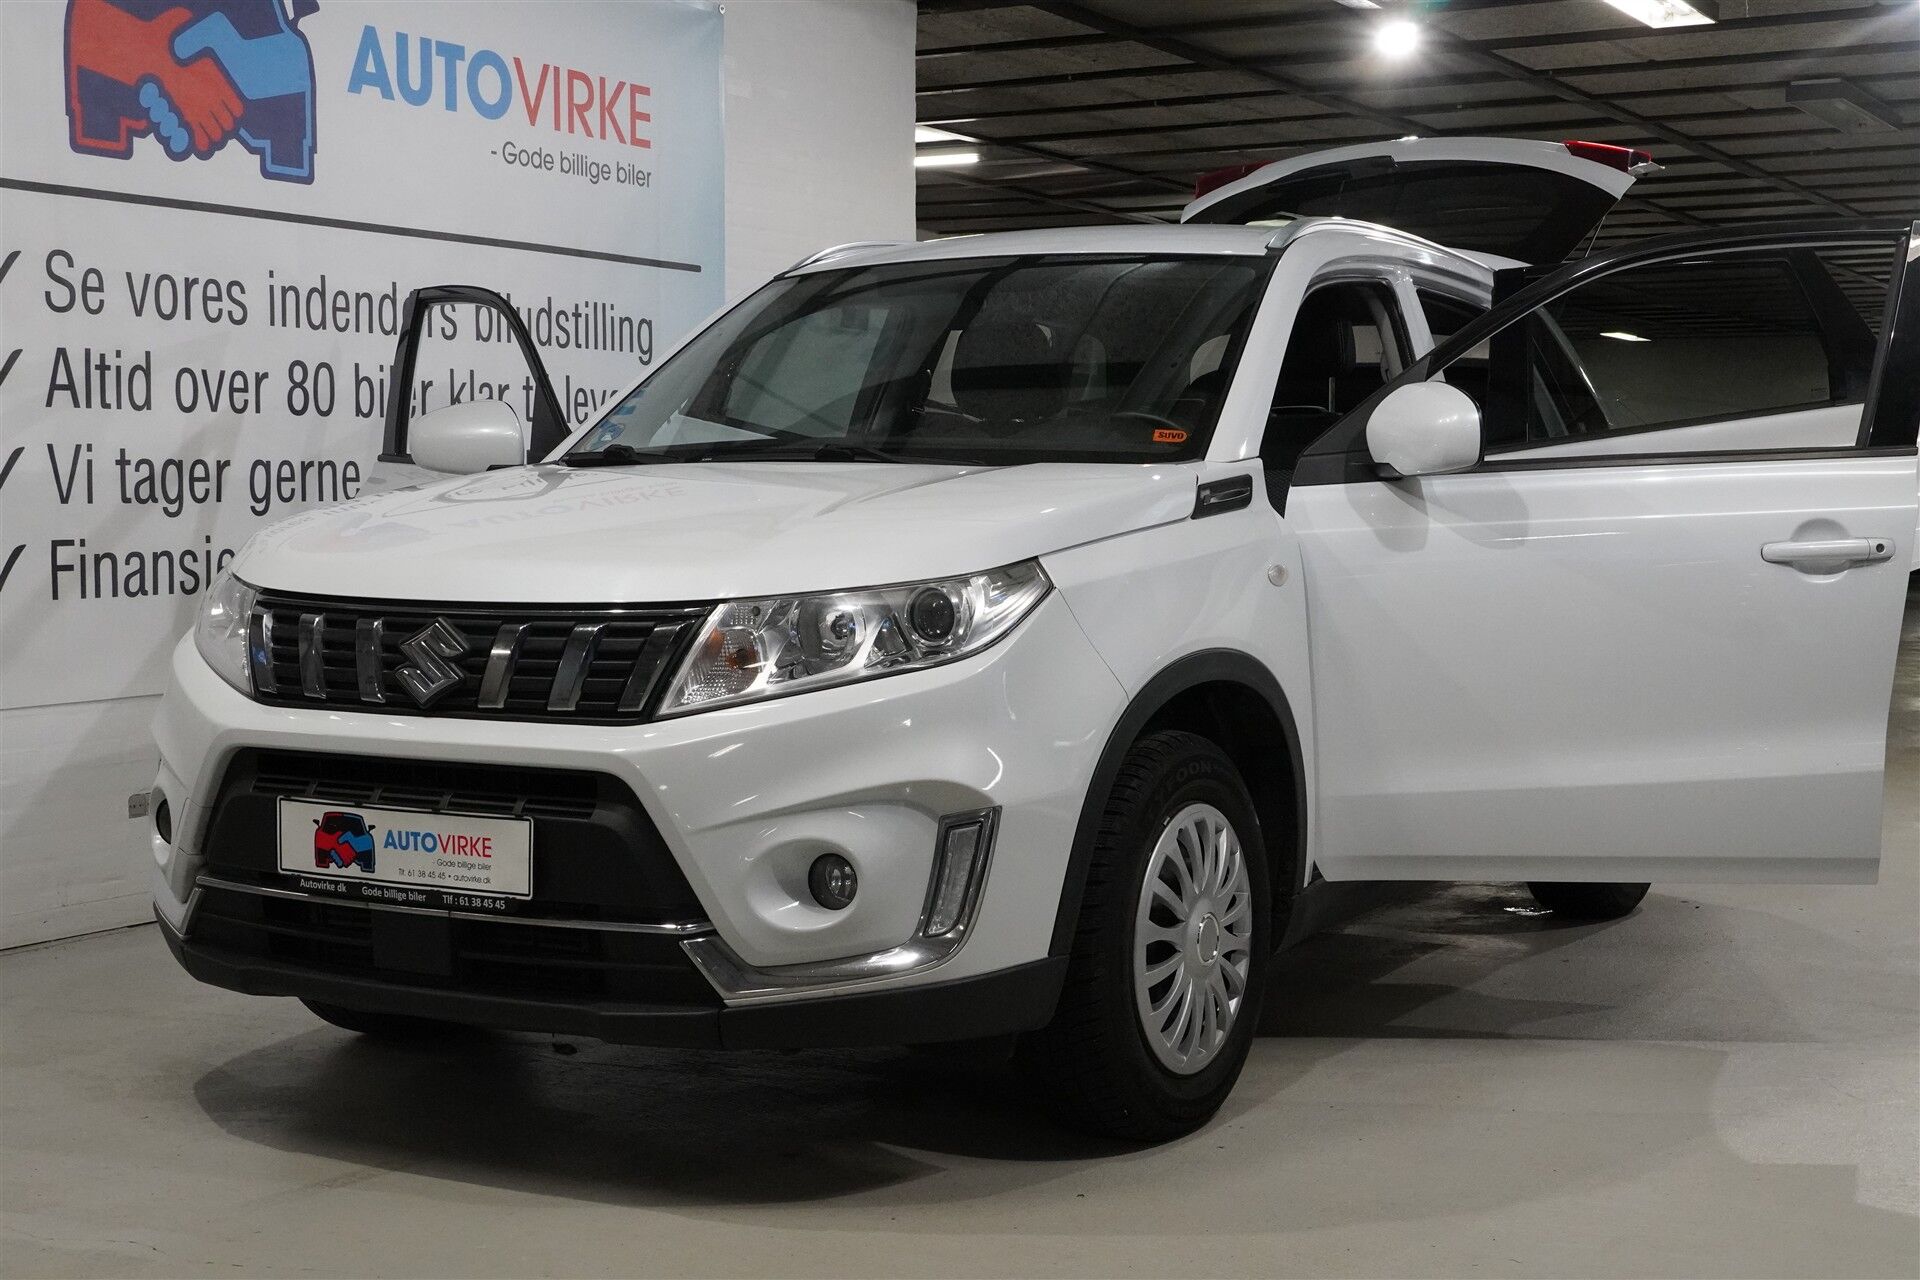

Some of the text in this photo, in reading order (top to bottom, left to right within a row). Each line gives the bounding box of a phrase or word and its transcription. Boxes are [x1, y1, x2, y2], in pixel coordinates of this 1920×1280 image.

[347, 24, 652, 149] AUTOVIRKE
[502, 140, 555, 172] Gode
[560, 151, 612, 185] billige
[616, 161, 653, 189] biler
[44, 249, 106, 316] Se
[125, 271, 248, 325] vores
[268, 269, 458, 341] indendrs
[45, 346, 153, 413] Altid
[174, 365, 270, 416] over
[286, 359, 339, 418] 80
[354, 362, 434, 419] bir
[47, 442, 94, 505] Vi
[115, 448, 231, 518] tager
[249, 460, 361, 517] gerne
[383, 829, 492, 858] AUTOVIRKE
[407, 869, 415, 877] 61
[418, 870, 426, 878] 38
[427, 871, 436, 879] 45
[437, 872, 446, 880] 45
[436, 858, 456, 868] Gode
[457, 860, 477, 871] billige
[477, 863, 492, 871] biler
[300, 878, 336, 892] Autovirke
[361, 886, 427, 902] Gode billige biler
[459, 895, 470, 906] 61
[471, 897, 482, 907] 38
[483, 898, 494, 909] 45
[494, 900, 506, 910] 45
